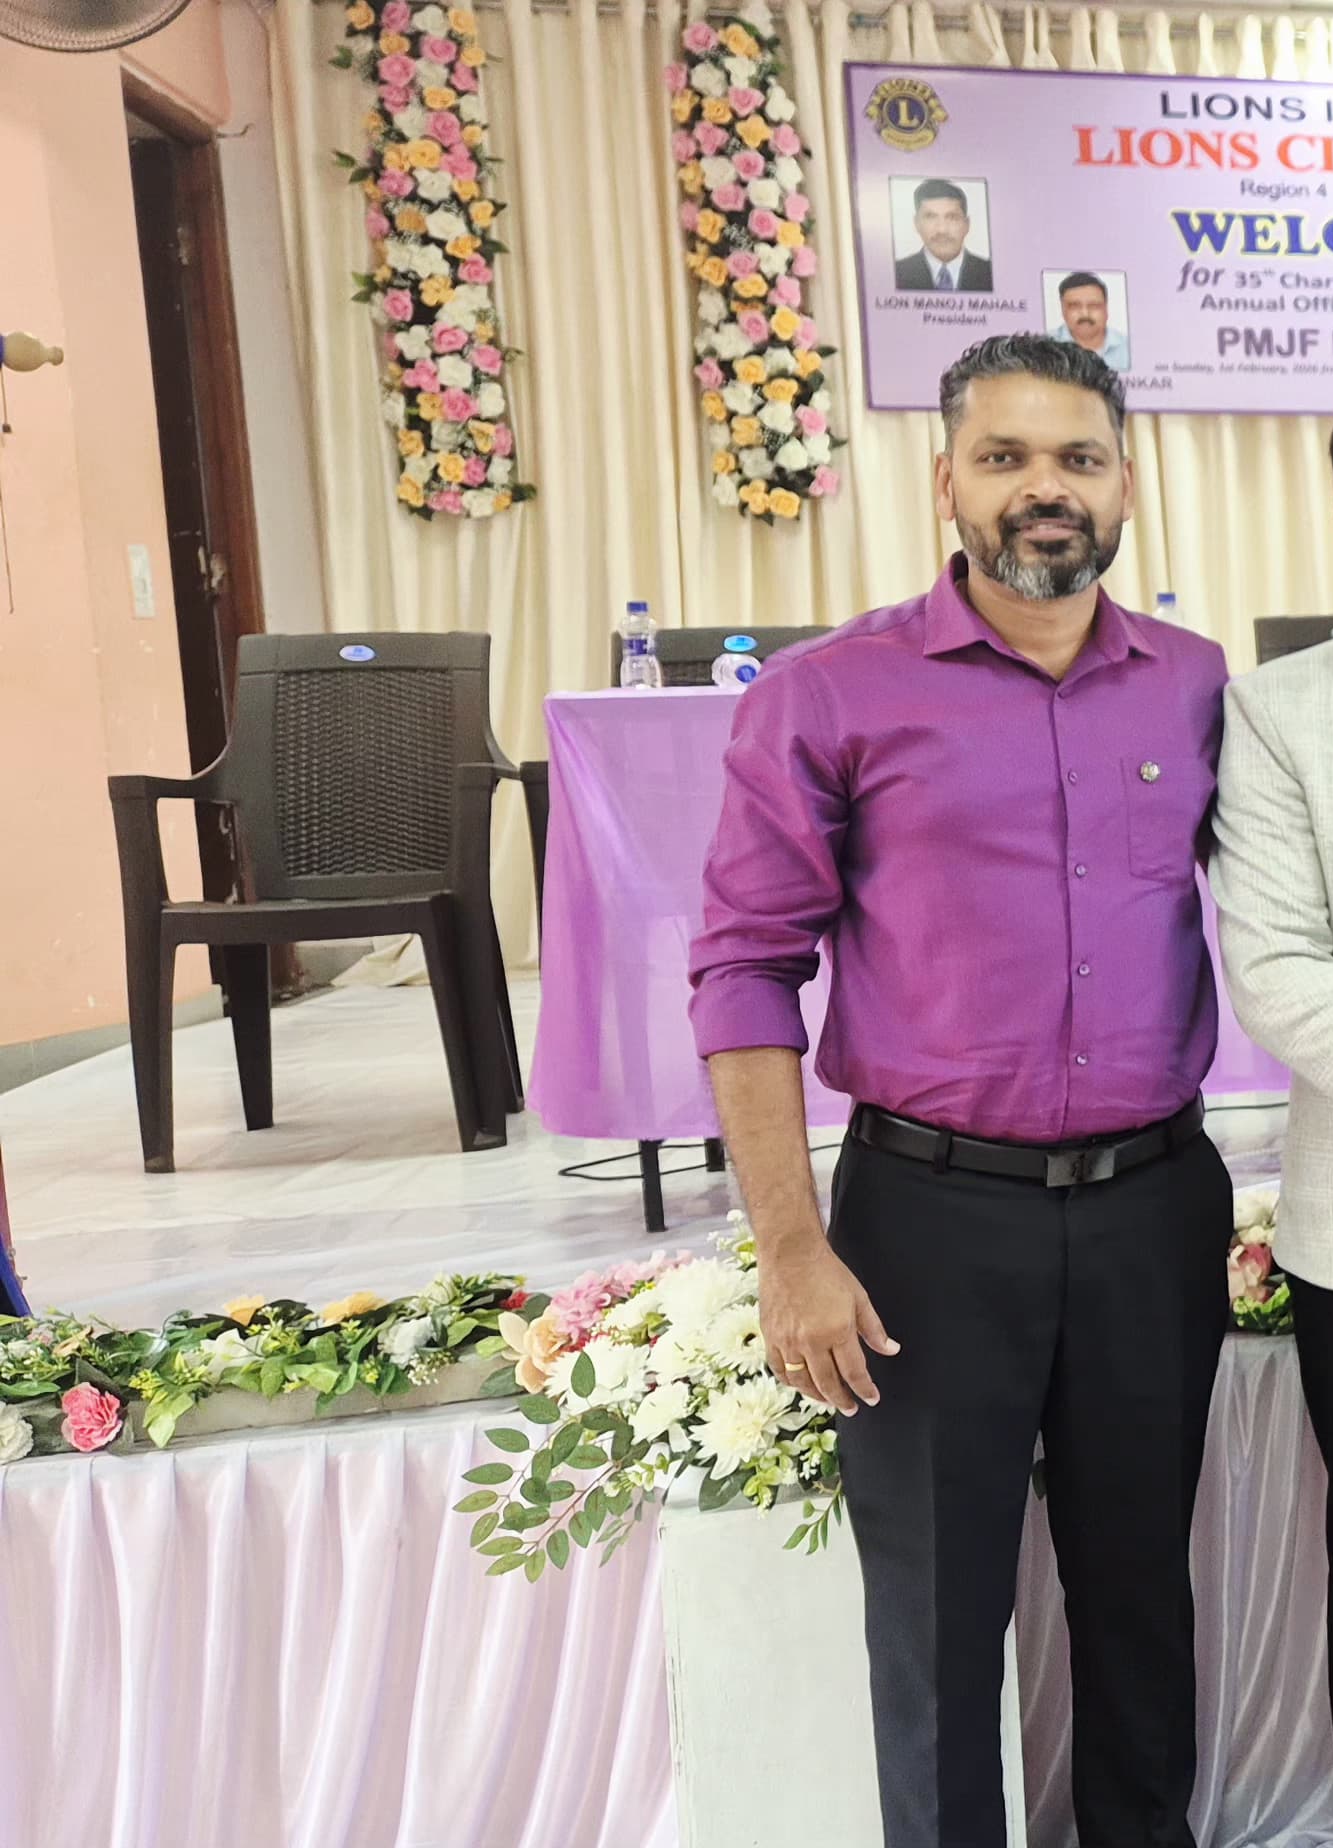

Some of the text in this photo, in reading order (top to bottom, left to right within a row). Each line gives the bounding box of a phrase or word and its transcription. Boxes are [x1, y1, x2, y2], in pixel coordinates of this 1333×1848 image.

[1159, 89, 1306, 122] LIONS
[1072, 124, 1261, 171] LIONS
[1239, 178, 1309, 201] Region
[1316, 183, 1328, 198] 4
[1176, 259, 1226, 293] for
[875, 296, 909, 311] LION
[967, 298, 1028, 313] MAHALE
[1200, 294, 1286, 313] Annual
[1216, 327, 1320, 359] PMJF
[1121, 375, 1174, 391] NKAR
